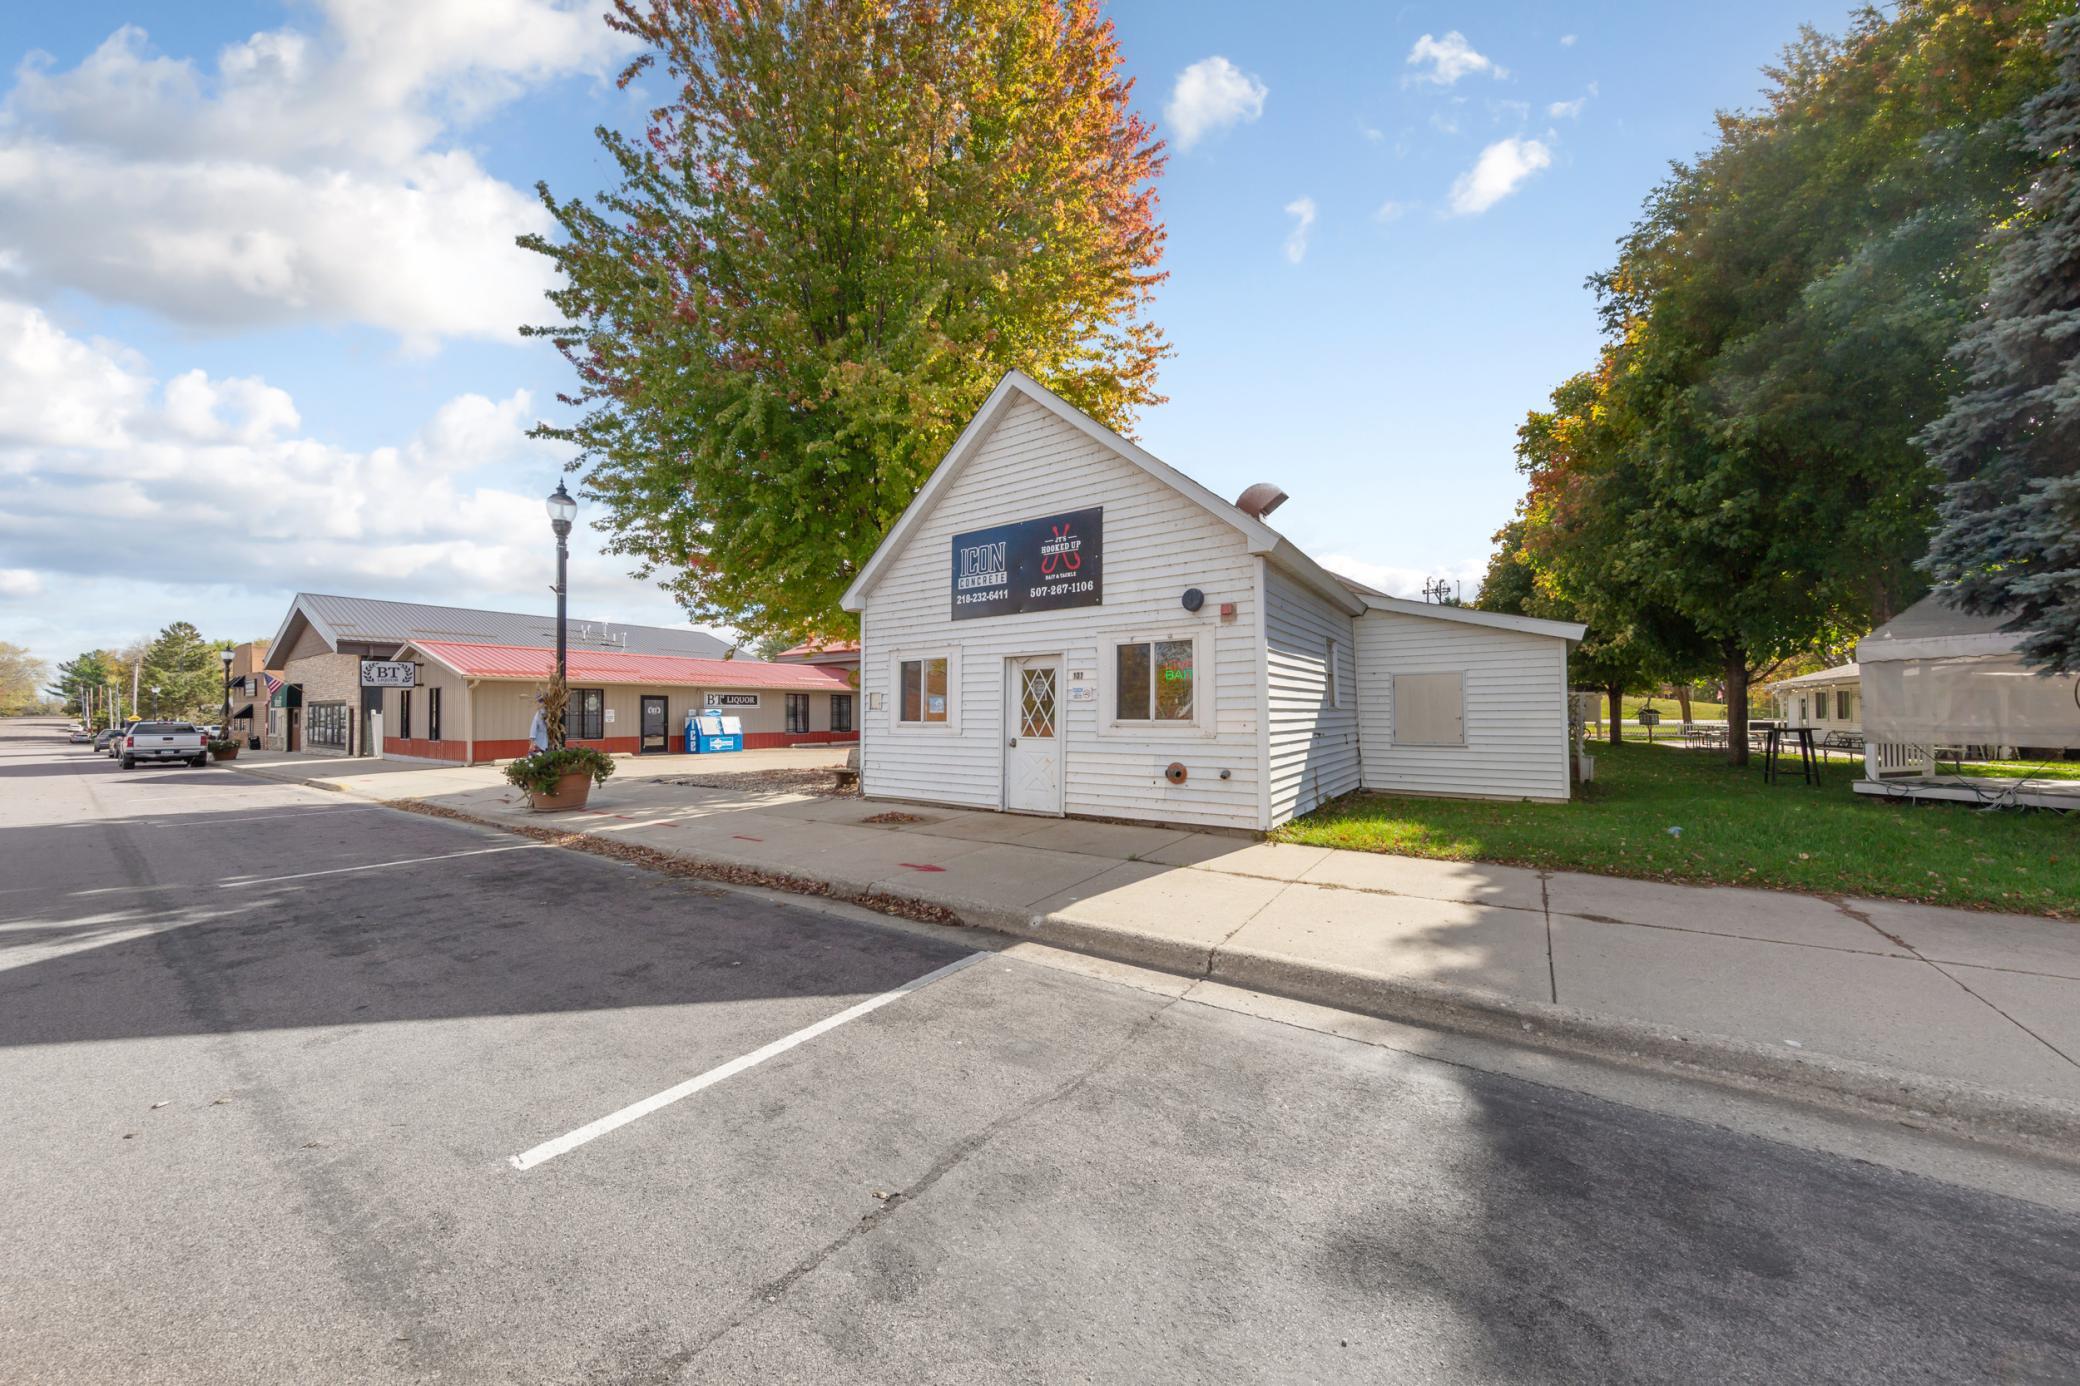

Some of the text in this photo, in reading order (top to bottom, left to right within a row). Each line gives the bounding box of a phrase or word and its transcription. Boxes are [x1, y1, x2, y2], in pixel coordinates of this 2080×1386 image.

[1041, 541, 1081, 554] HOOKED UP
[960, 542, 1006, 577] ICON
[960, 573, 1006, 587] CONCRETE
[1030, 580, 1094, 598] 507-267-1106
[957, 589, 1009, 604] 218-232-6411
[376, 666, 400, 678] BT
[707, 694, 755, 705] BT LIQUOR
